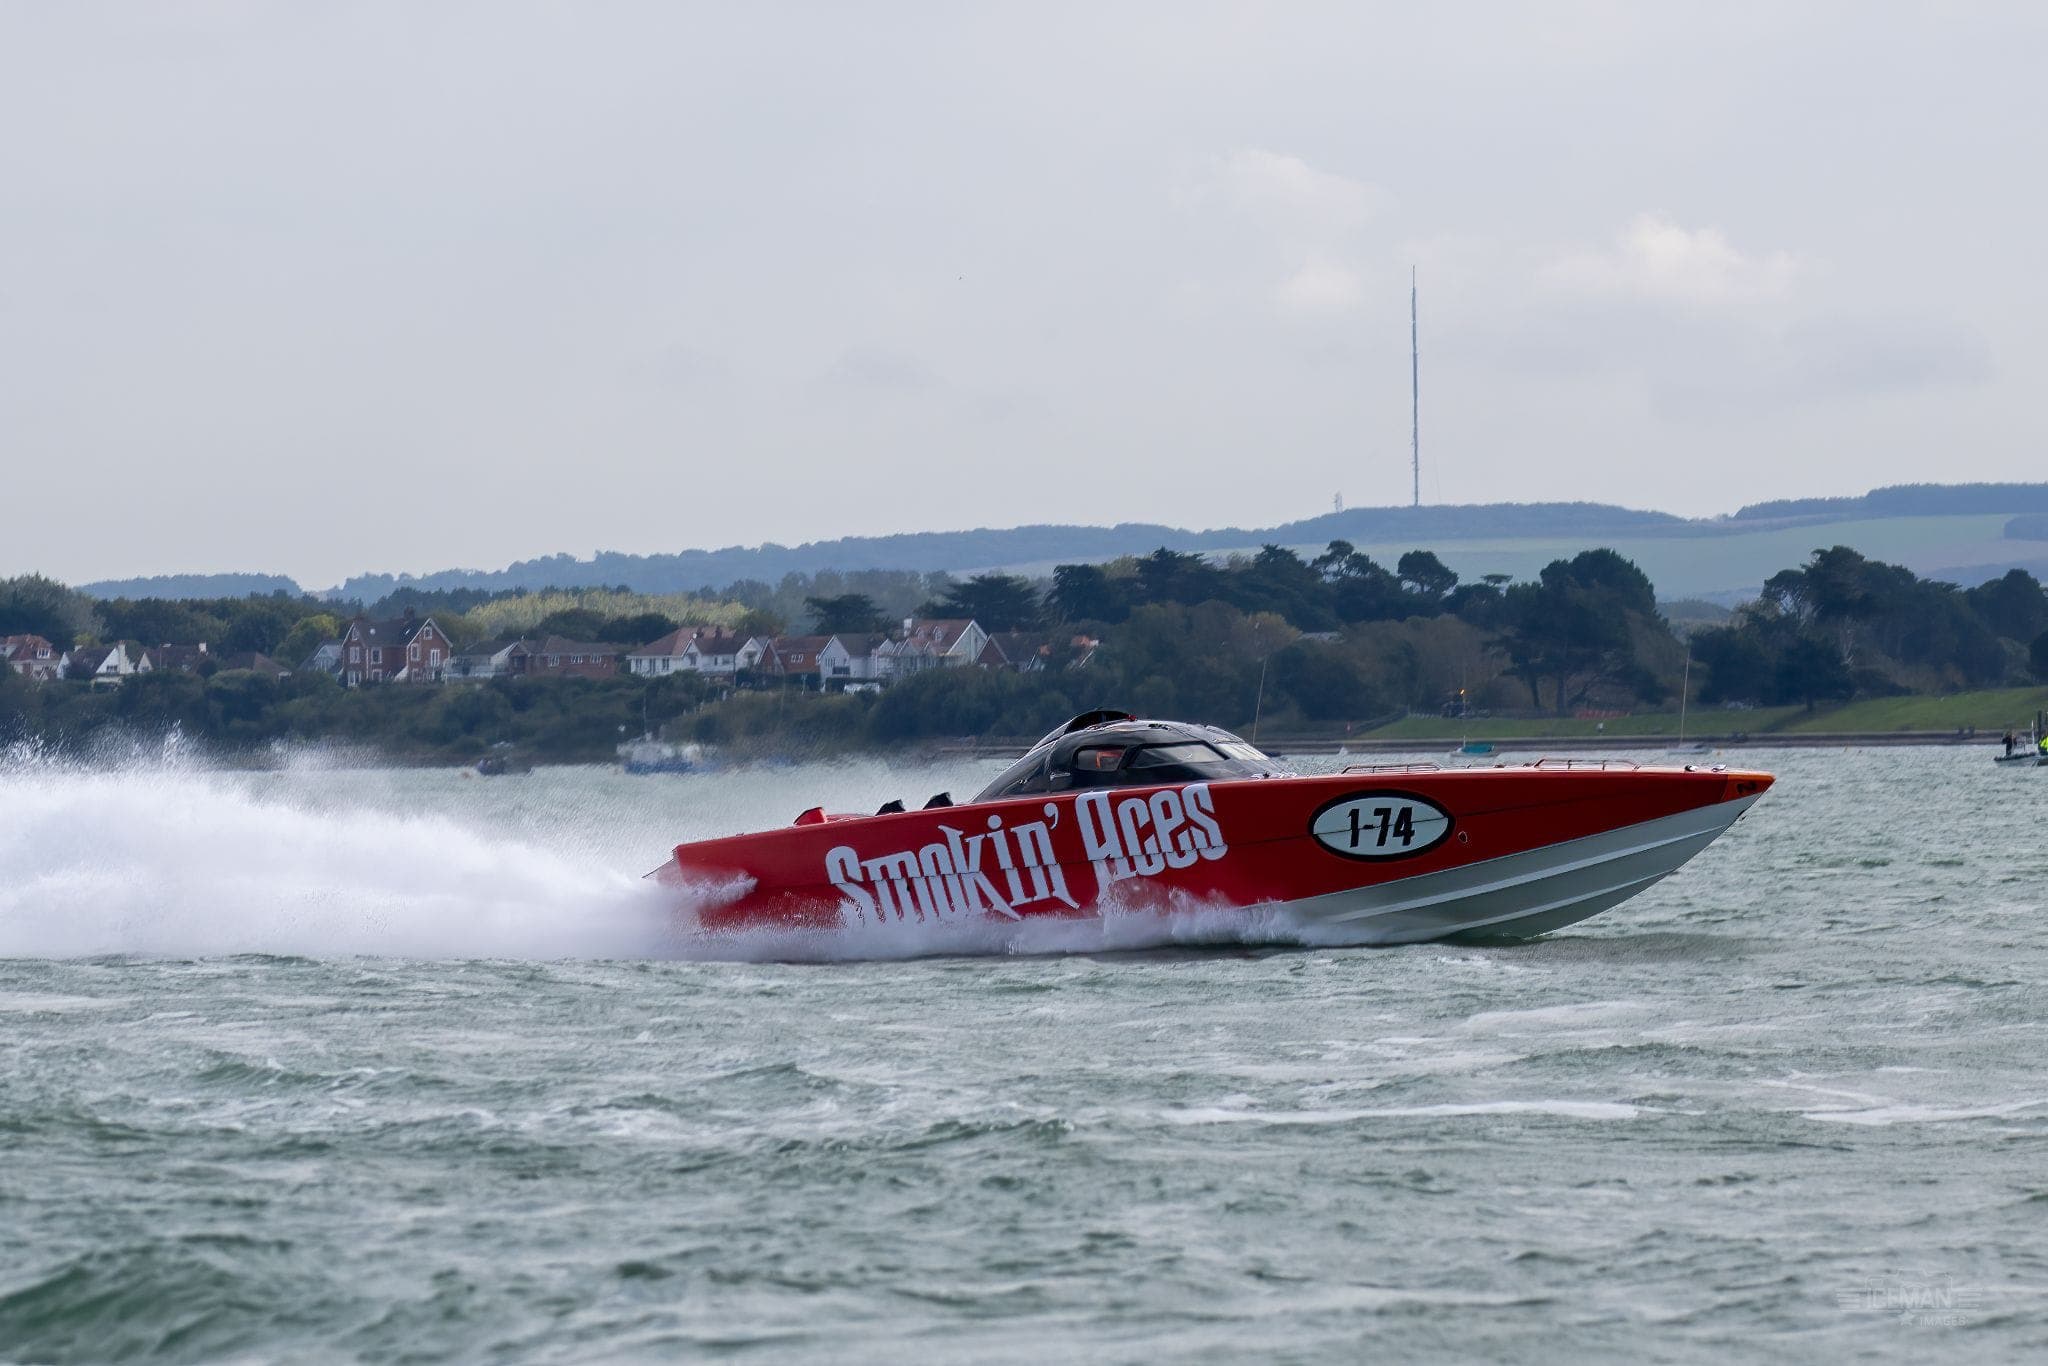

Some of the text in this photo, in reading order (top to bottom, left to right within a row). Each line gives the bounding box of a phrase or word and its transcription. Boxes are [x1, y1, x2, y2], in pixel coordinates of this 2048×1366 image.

[825, 783, 1228, 925] Smokin' Aces
[1347, 806, 1416, 848] 1-74
